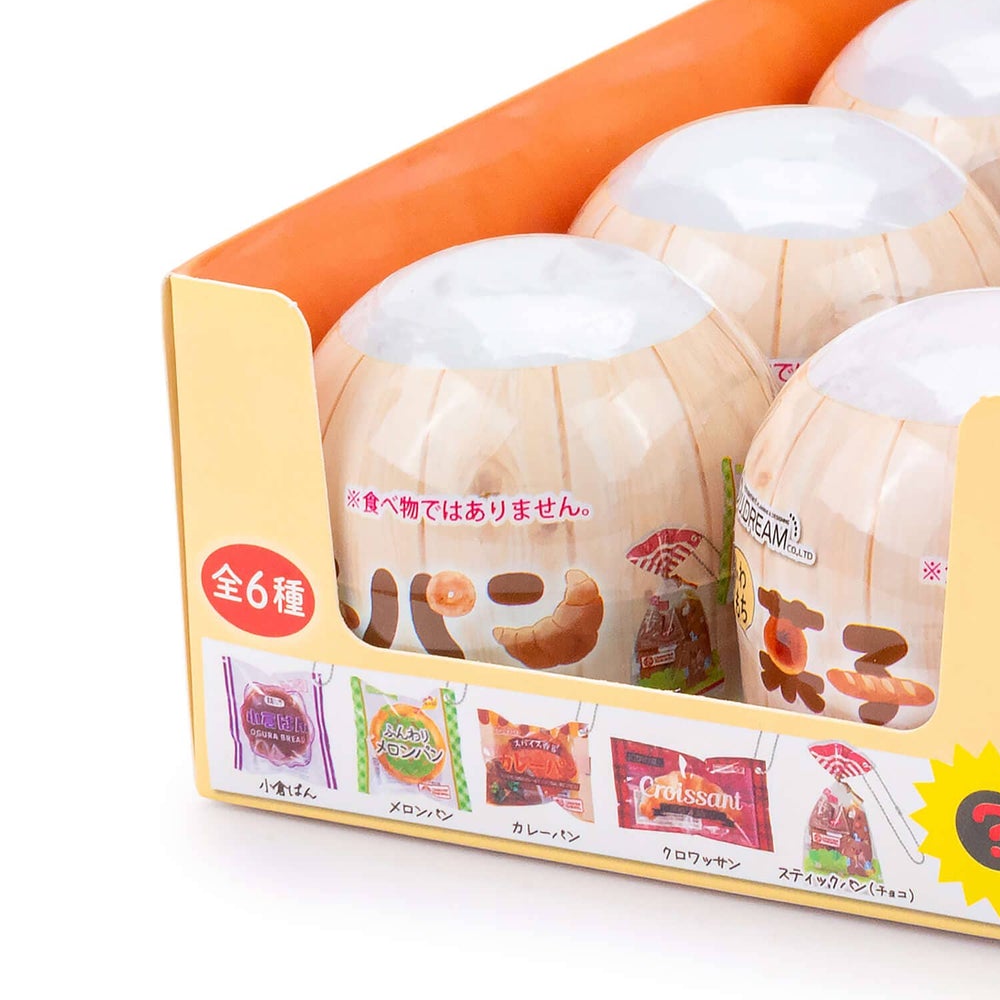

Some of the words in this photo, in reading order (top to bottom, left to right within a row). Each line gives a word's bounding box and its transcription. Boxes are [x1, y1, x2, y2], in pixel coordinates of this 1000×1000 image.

[347, 490, 590, 522] ※食べ物ではありません。
[211, 562, 306, 618] 全6種
[336, 557, 605, 669] パン
[384, 723, 430, 744] ふんわり
[376, 739, 444, 763] メロンパン
[259, 777, 317, 800] 小倉ぱん
[639, 775, 744, 811] Croissant
[388, 801, 453, 822] メロンパン
[512, 821, 581, 843] カレーパン
[662, 846, 742, 871] クロワッサン
